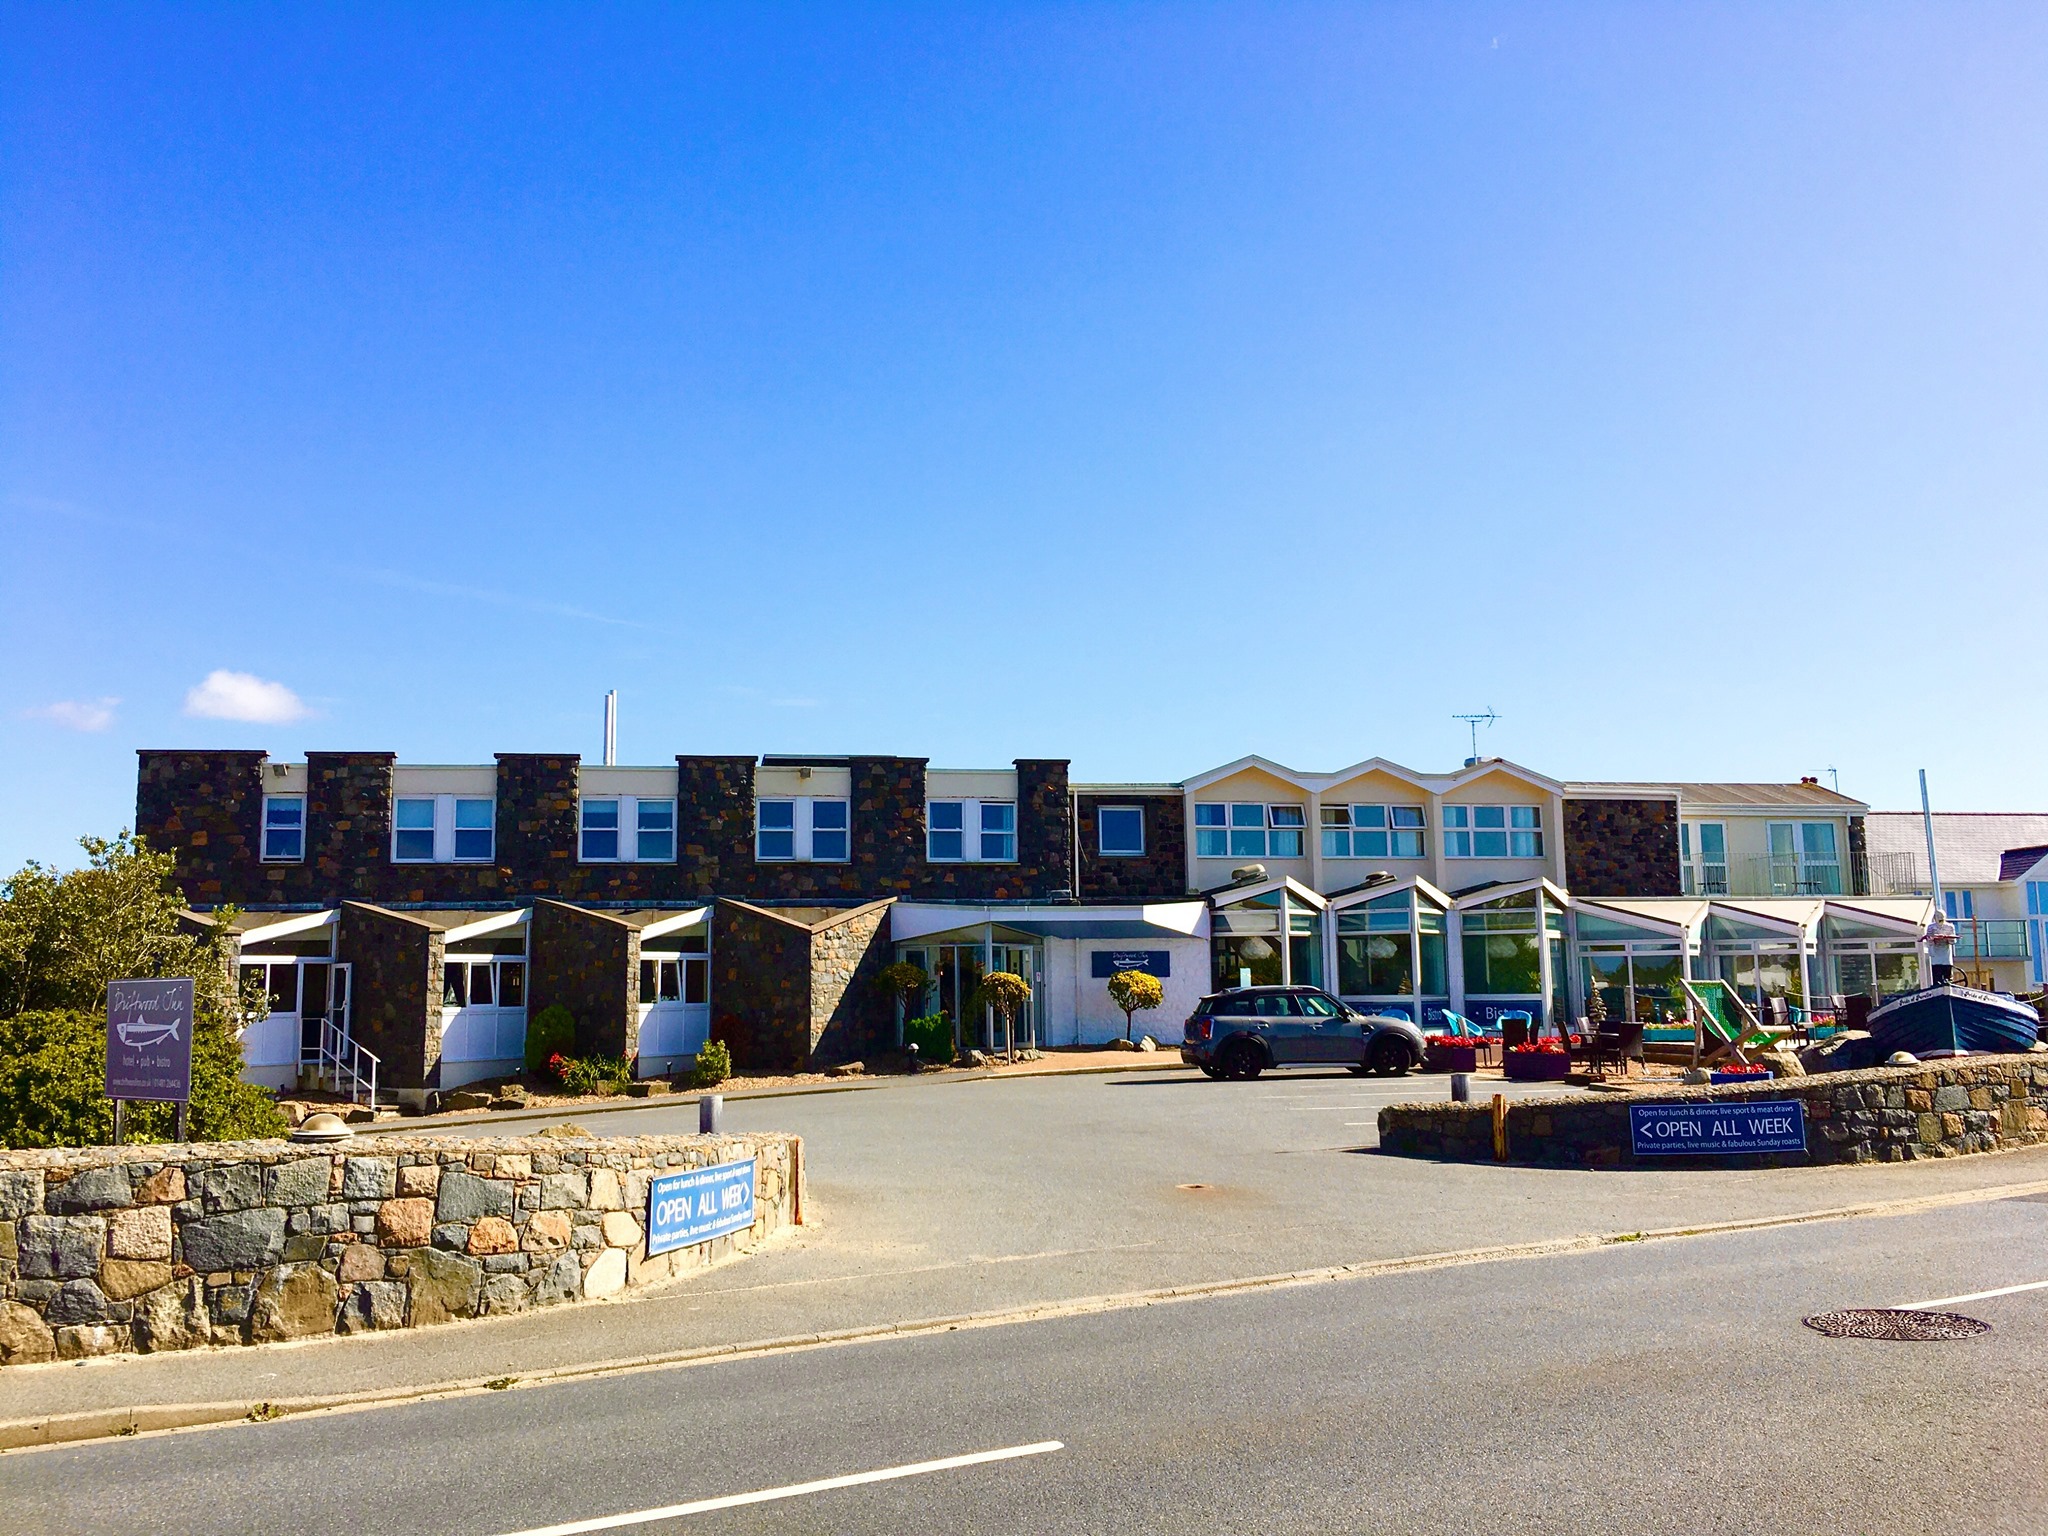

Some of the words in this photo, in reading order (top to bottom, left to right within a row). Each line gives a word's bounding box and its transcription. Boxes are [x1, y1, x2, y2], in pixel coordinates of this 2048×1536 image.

[114, 990, 159, 1022] Driftwood
[163, 988, 184, 1011] Inn
[140, 1055, 150, 1069] pub
[157, 1055, 171, 1067] bistro
[1638, 1109, 1658, 1118] Open
[1658, 1108, 1668, 1116] for
[1669, 1108, 1688, 1116] lunch
[1689, 1108, 1695, 1116] &
[1696, 1108, 1720, 1116] dinner,
[1720, 1107, 1732, 1115] live
[1733, 1106, 1750, 1115] sport
[1656, 1121, 1702, 1138] OPEN
[1712, 1120, 1742, 1136] ALL
[1748, 1117, 1794, 1135] WEEK
[1661, 1142, 1686, 1150] parties,
[1721, 1140, 1727, 1148] &
[1757, 1139, 1780, 1147] Sunday
[658, 1182, 672, 1194] Open
[672, 1180, 681, 1190] for
[681, 1177, 695, 1189] lunch
[656, 1196, 692, 1226] OPEN
[697, 1190, 718, 1217] ALL
[722, 1184, 742, 1210] WEEK
[652, 1231, 672, 1244] Private
[671, 1228, 688, 1242] parties,
[690, 1225, 698, 1236] live
[699, 1220, 712, 1233] music
